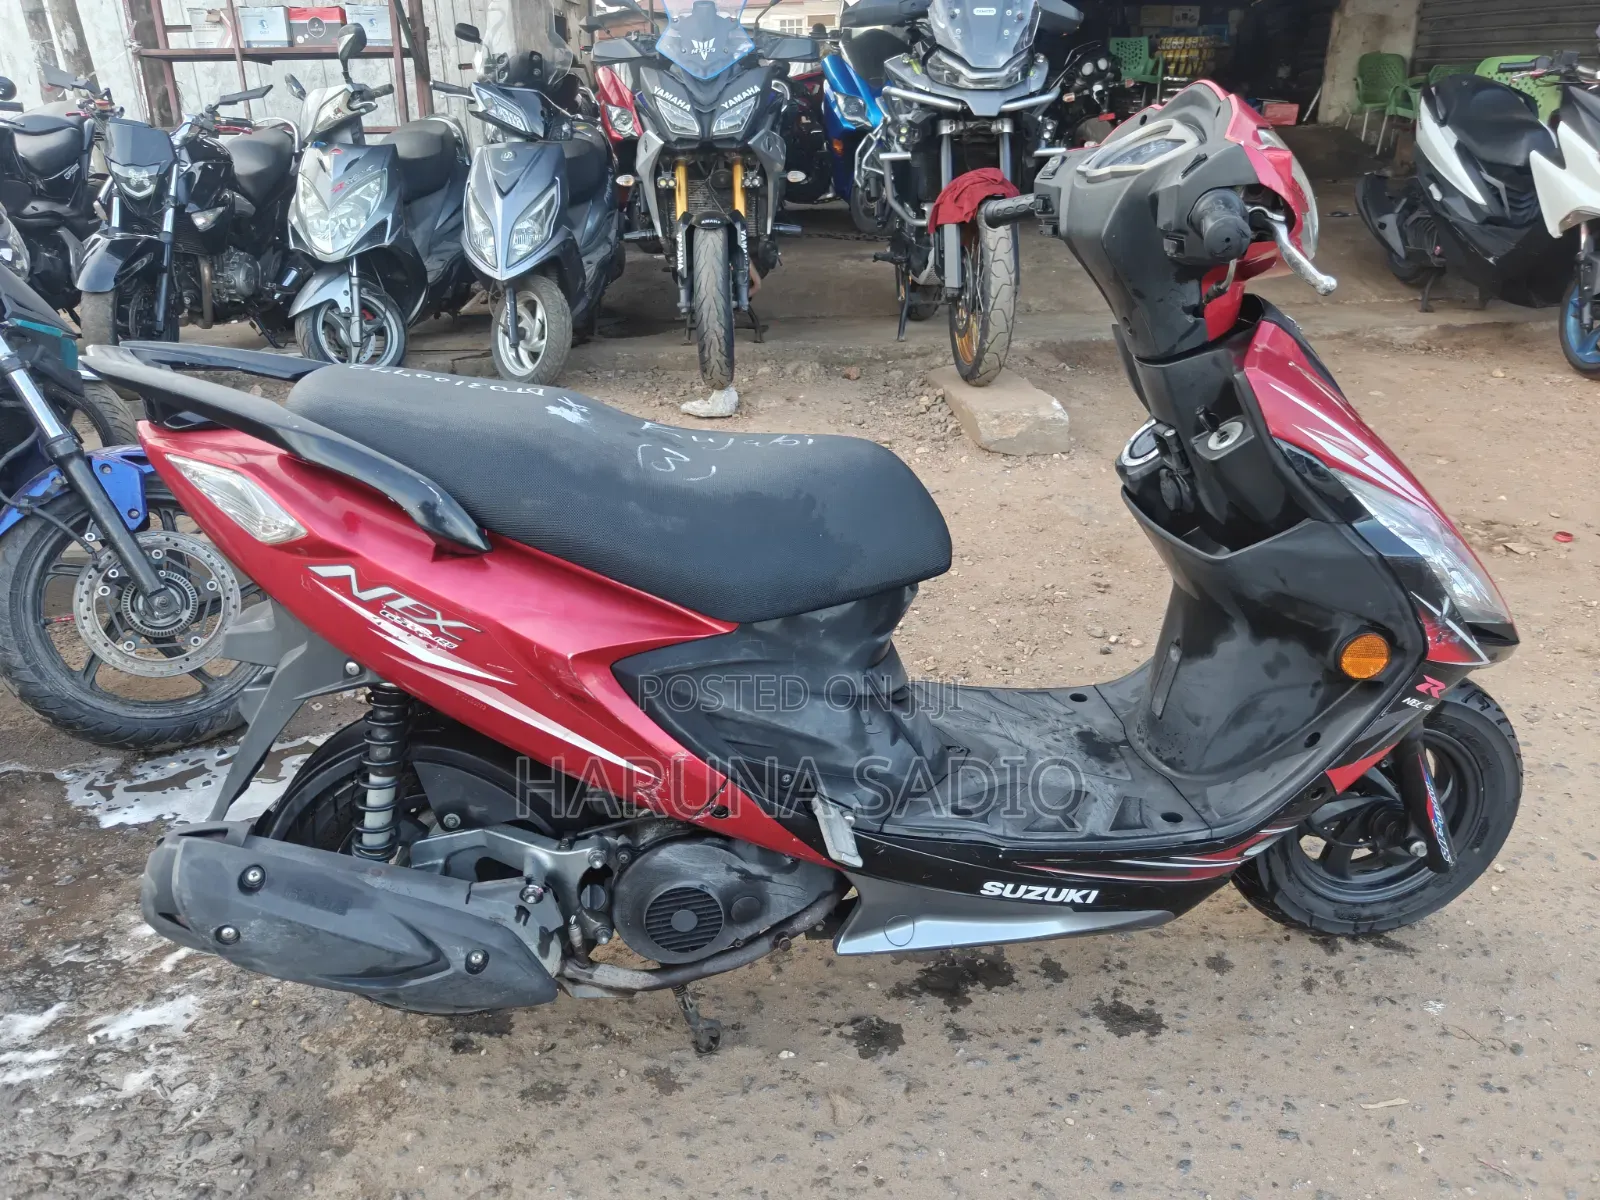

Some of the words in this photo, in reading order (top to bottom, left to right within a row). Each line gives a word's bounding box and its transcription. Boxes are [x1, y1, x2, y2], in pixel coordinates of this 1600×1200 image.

[652, 85, 691, 111] YAMAHA
[721, 85, 761, 109] YAMAHA
[307, 564, 484, 642] NEX
[979, 881, 1099, 904] SUZUKI
